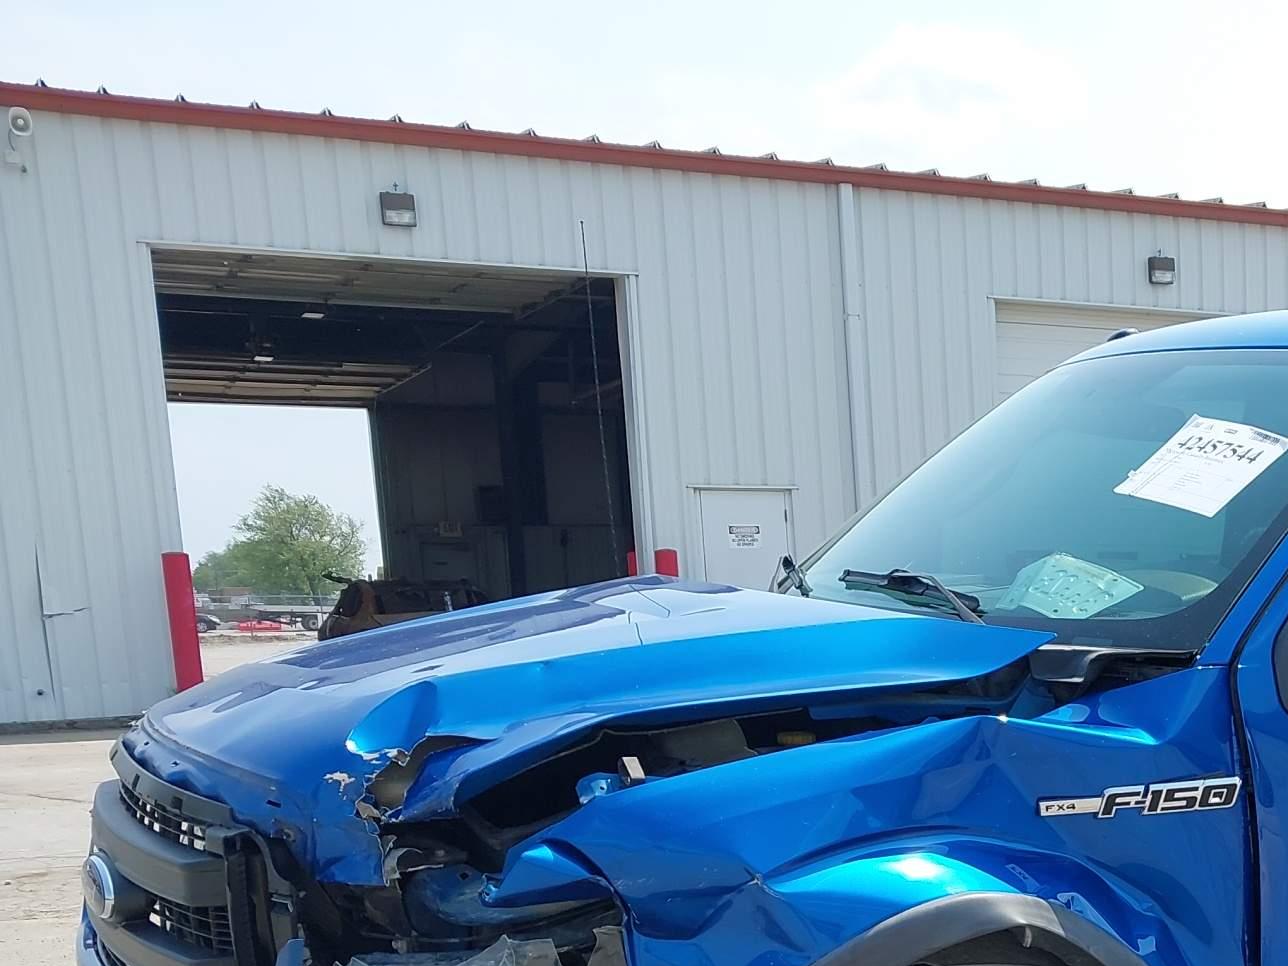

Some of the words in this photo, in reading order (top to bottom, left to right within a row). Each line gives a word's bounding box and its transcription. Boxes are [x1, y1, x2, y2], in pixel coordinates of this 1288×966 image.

[1177, 434, 1265, 465] 42457544
[1044, 802, 1077, 813] FX4
[1097, 776, 1242, 818] F-150
